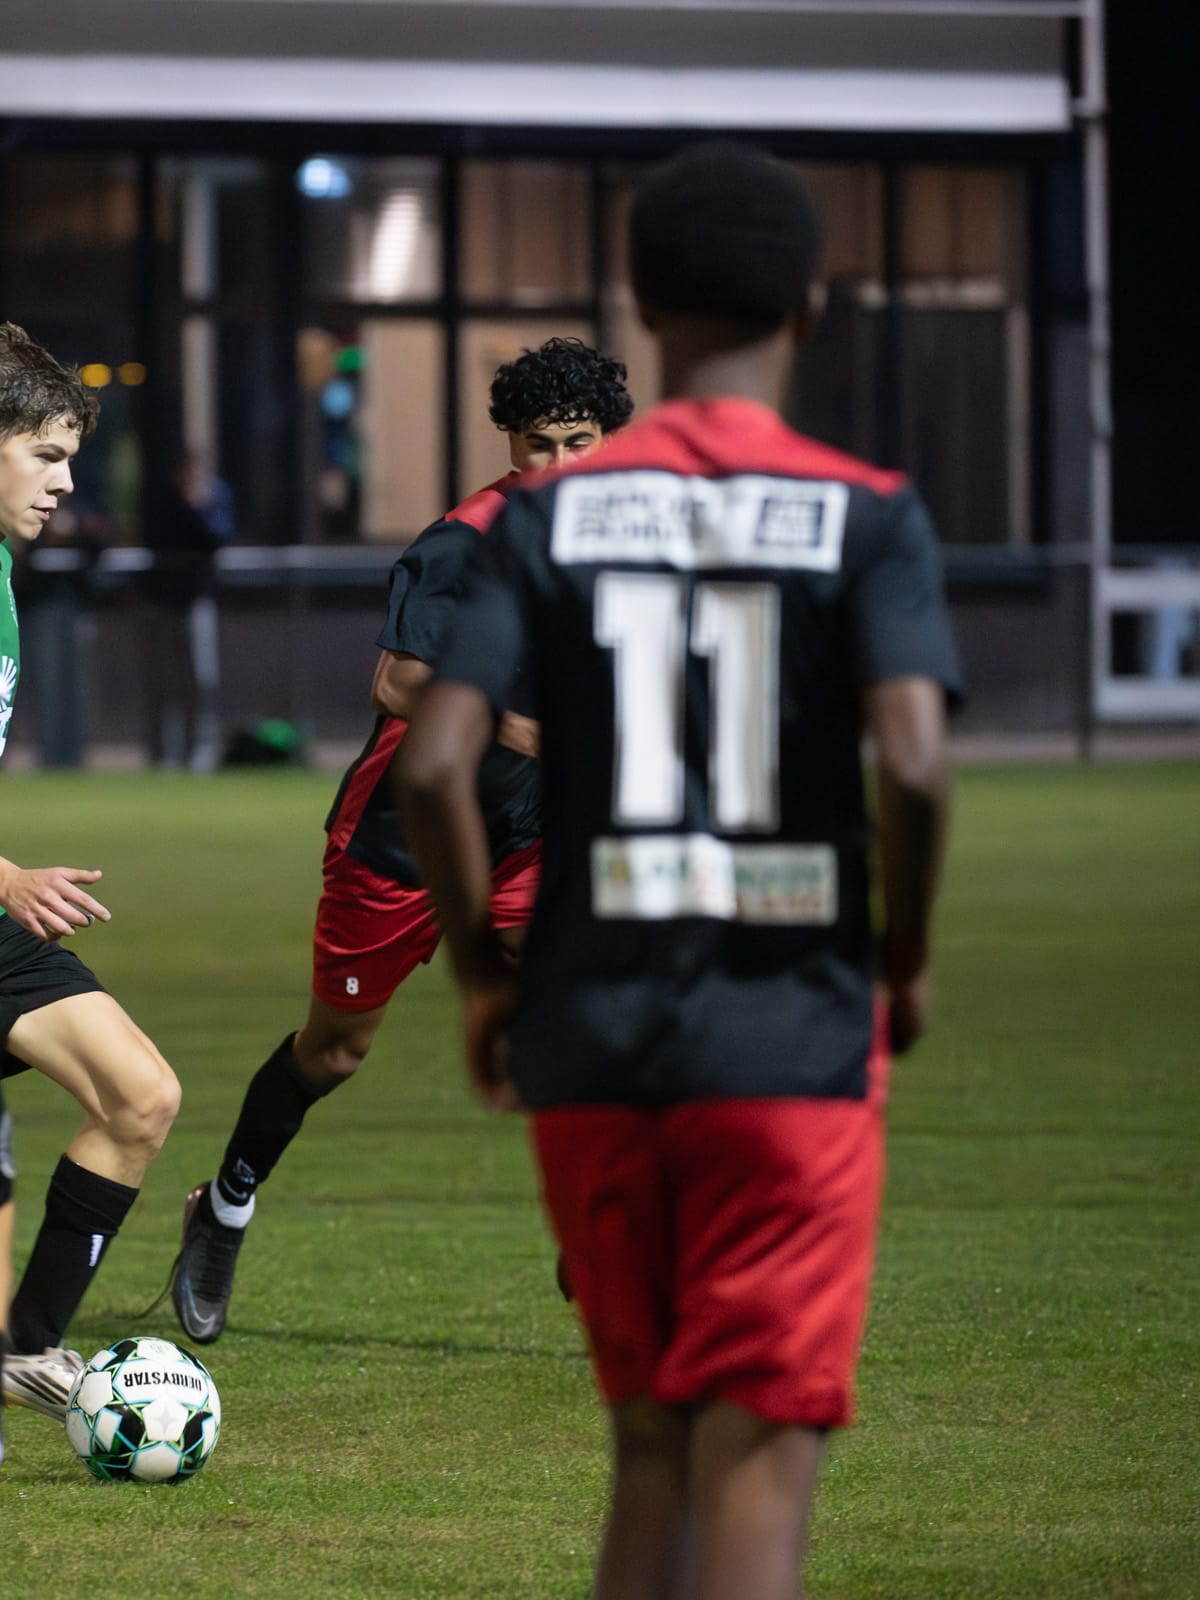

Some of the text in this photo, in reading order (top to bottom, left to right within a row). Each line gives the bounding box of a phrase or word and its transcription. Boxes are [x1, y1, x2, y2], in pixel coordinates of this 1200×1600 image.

[594, 571, 780, 833] 11
[346, 977, 359, 995] 8
[123, 1371, 202, 1391] DERBYSTAR
